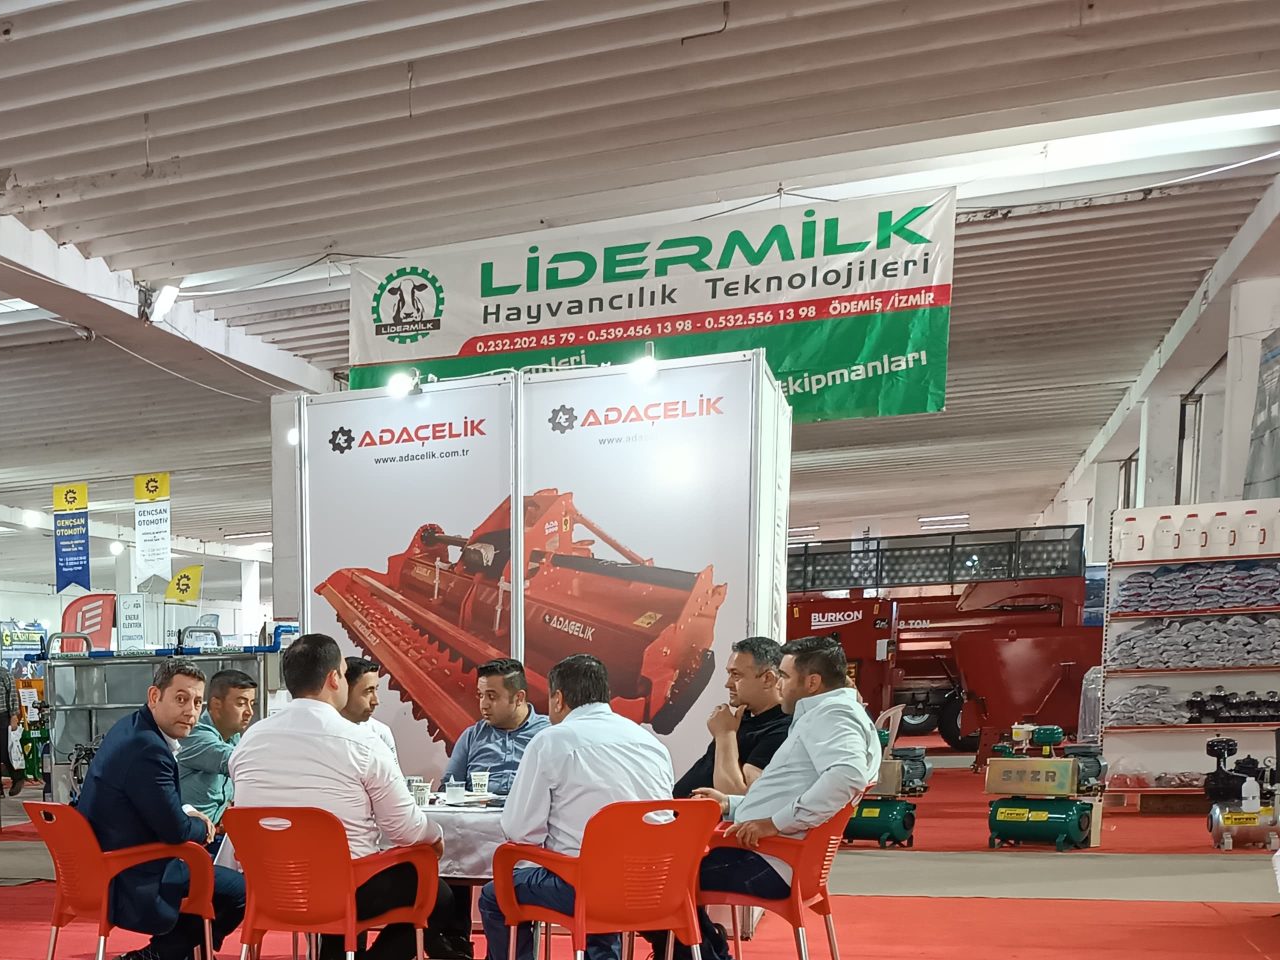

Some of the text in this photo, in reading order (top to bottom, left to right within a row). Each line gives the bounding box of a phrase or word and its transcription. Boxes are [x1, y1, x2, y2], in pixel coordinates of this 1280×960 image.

[480, 204, 933, 298] LİDERMİLK
[482, 252, 931, 325] Hayvancılık Teknolojileri
[476, 336, 537, 353] 0.232.202
[540, 334, 556, 346] 45
[560, 332, 575, 345] 79
[587, 324, 652, 342] 0.539.456
[656, 323, 673, 335] 13
[676, 321, 693, 332] 98
[705, 311, 773, 330] 0.532.556
[778, 308, 795, 321] 13
[799, 306, 817, 318] 98
[829, 295, 883, 316] ÖDEMİŞ
[580, 394, 725, 427] ADAÇELİK
[357, 416, 487, 447] ADAÇELİK
[374, 449, 470, 464] www.adacelik.com.tr
[812, 610, 863, 622] BURKON
